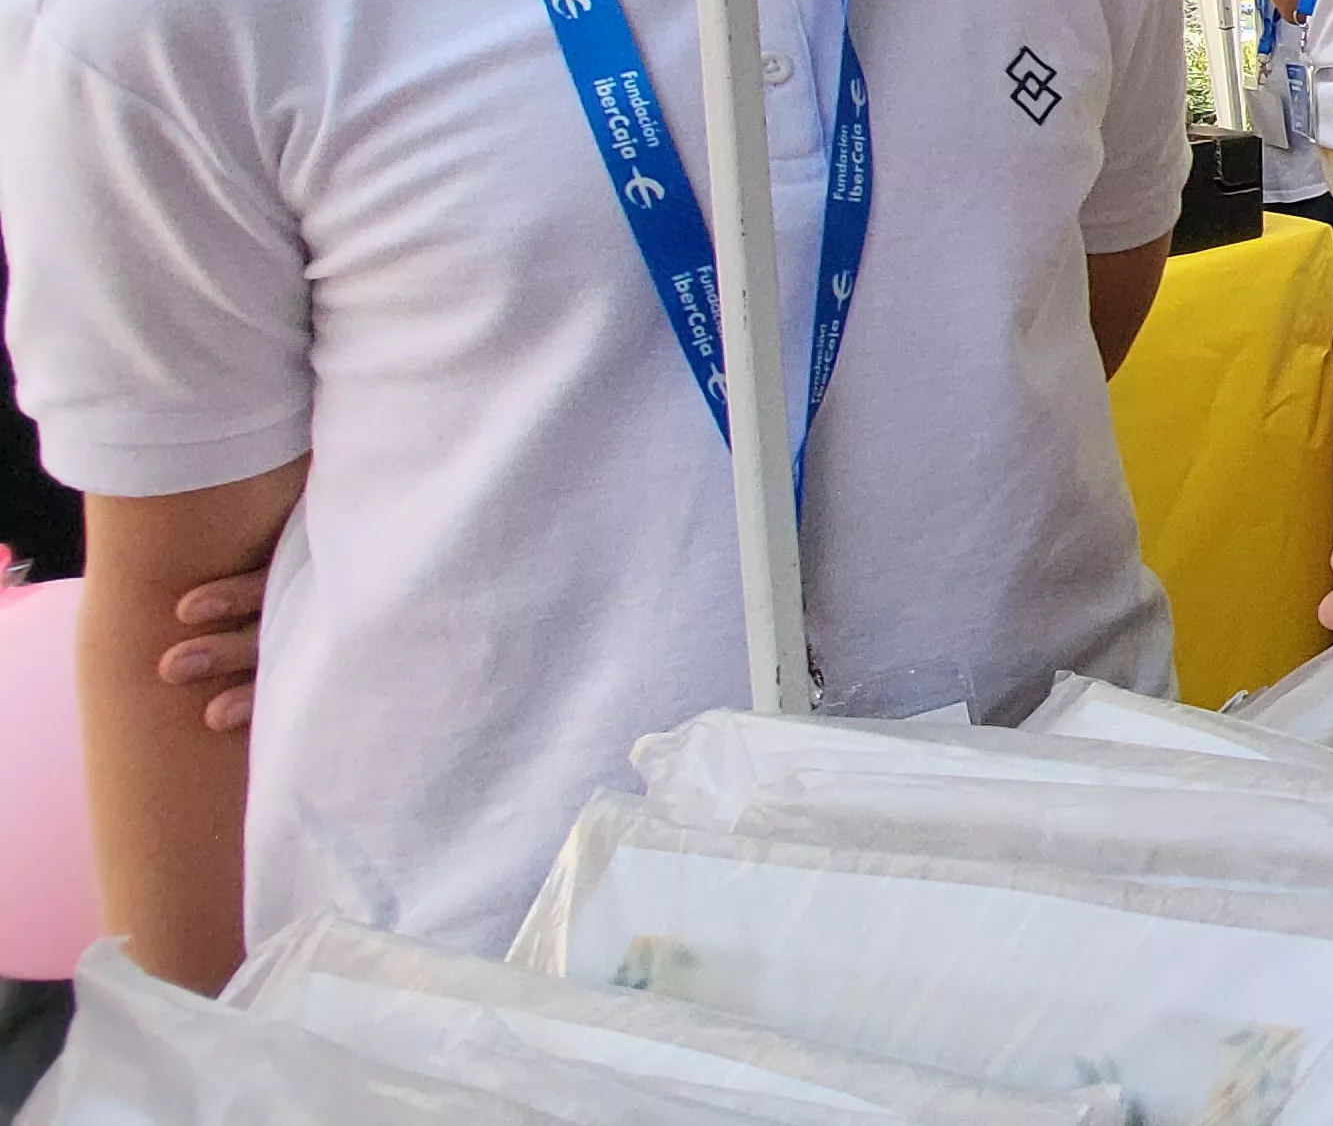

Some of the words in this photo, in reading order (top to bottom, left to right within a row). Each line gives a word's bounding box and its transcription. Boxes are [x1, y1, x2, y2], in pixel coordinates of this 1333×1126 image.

[594, 78, 636, 161] iberCaja
[620, 70, 660, 149] Fundación
[670, 272, 714, 358] iberCaja
